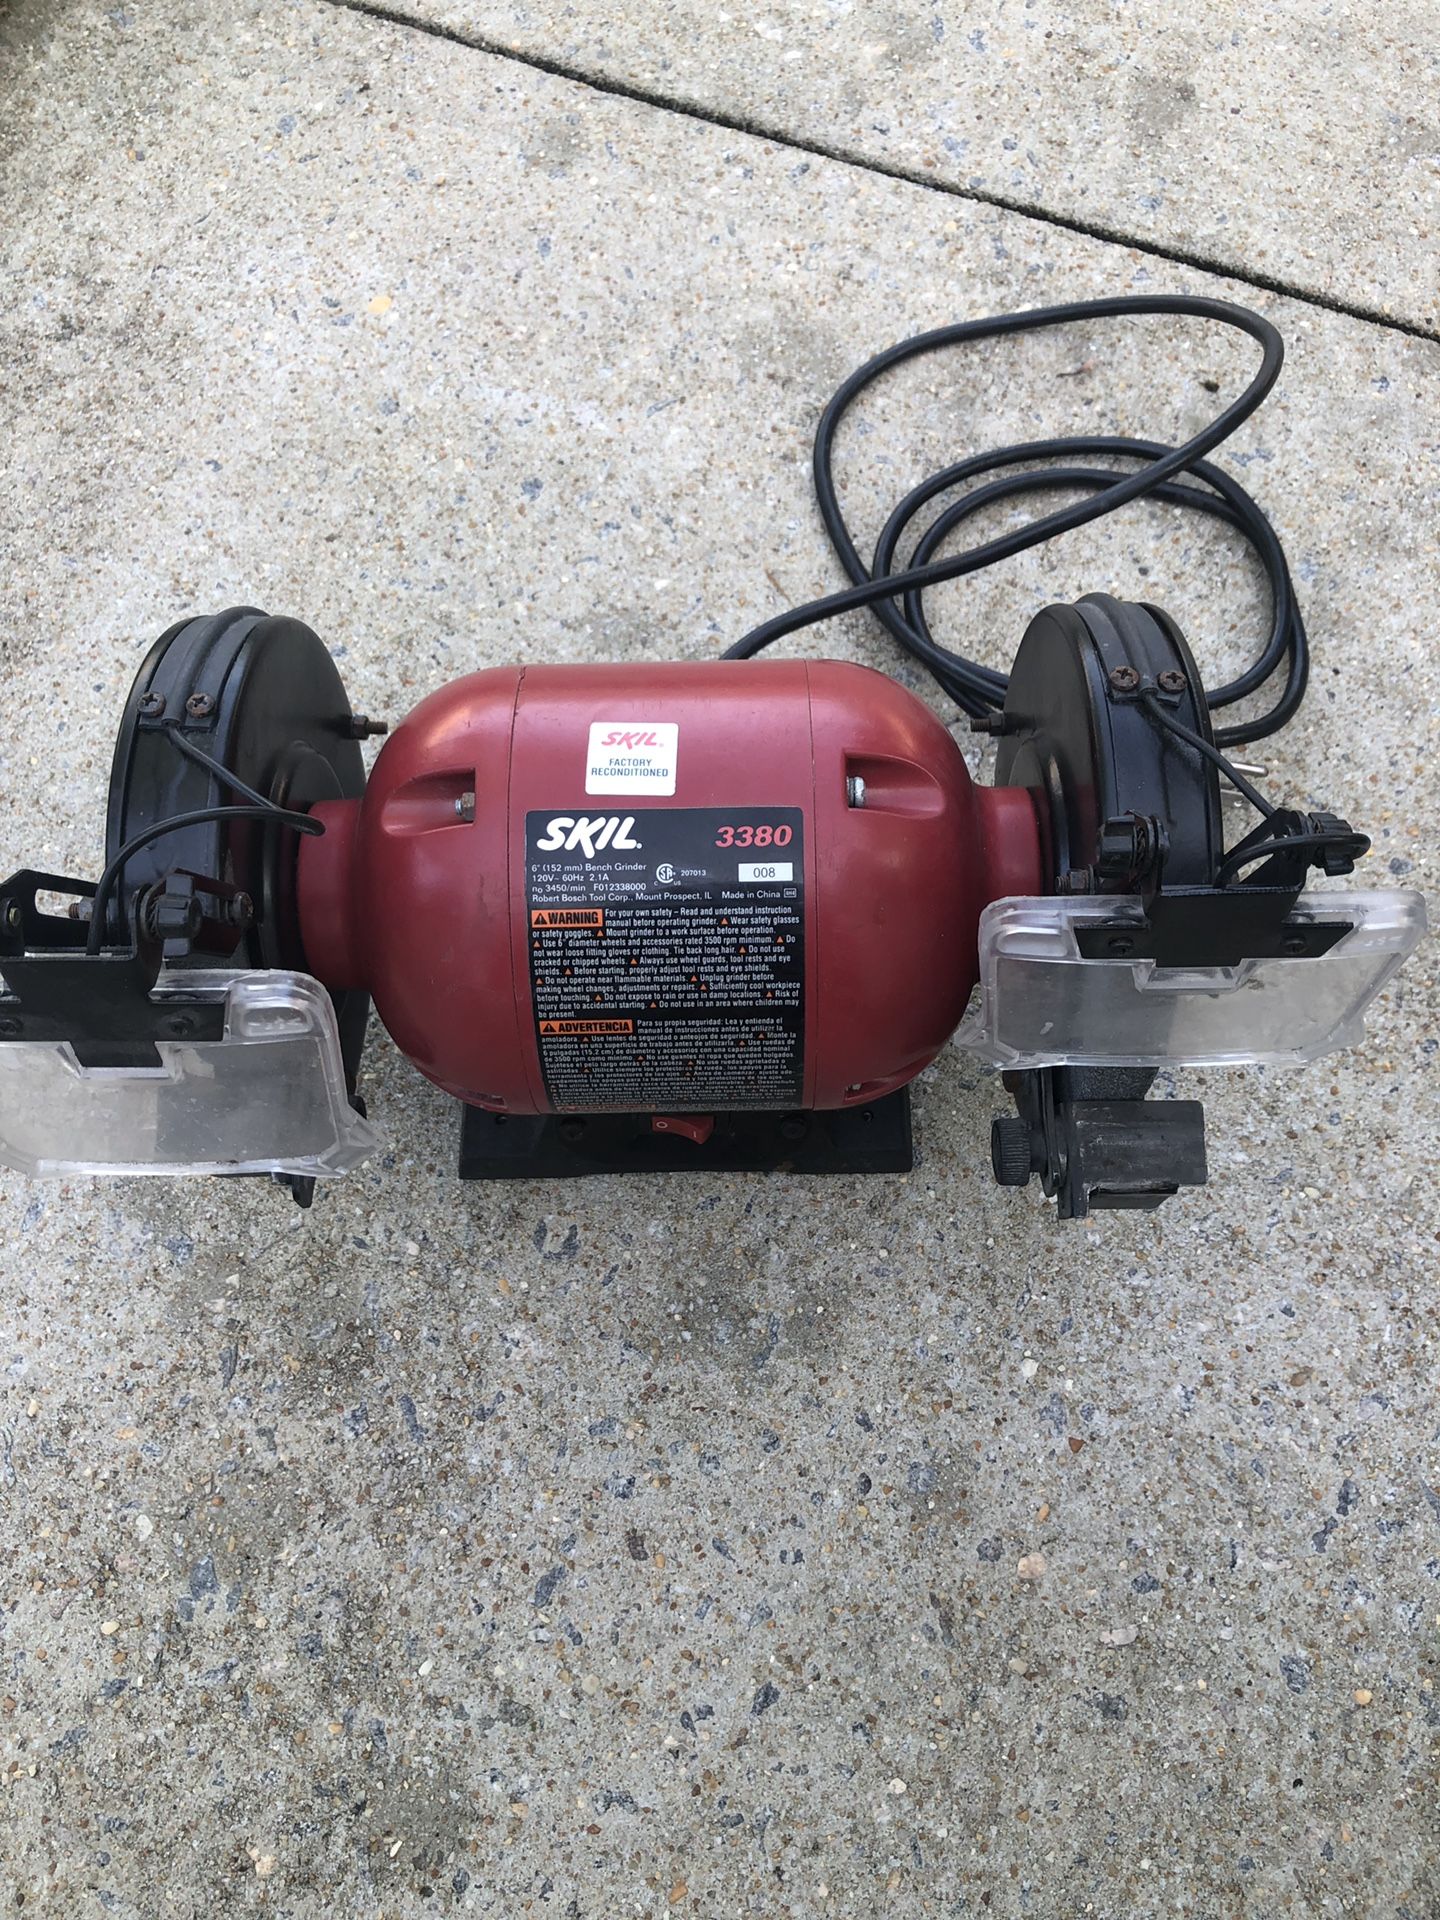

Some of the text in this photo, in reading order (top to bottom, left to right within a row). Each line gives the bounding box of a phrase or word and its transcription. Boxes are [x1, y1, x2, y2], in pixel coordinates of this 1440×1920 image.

[608, 758, 652, 767] FACTORY
[591, 768, 668, 777] RECONDITIONED
[715, 825, 792, 848] 3380
[542, 864, 562, 872] (152
[564, 864, 583, 872] mm)
[586, 863, 612, 871] Bench
[614, 862, 647, 871] Grinder
[590, 873, 609, 881] 2.1A
[753, 867, 775, 878] 008
[545, 882, 646, 892] 3450/min F012338000
[532, 894, 559, 902] Robert
[562, 894, 587, 902] Bosch
[705, 892, 712, 900] IL
[722, 891, 744, 899] Made
[747, 890, 754, 899] in
[756, 890, 780, 898] China
[619, 909, 633, 918] your
[652, 908, 672, 916] safety
[715, 906, 753, 915] understand
[755, 906, 792, 914] instruction
[548, 912, 598, 924] WARNING
[692, 918, 718, 926] grinder.
[751, 916, 771, 925] safety
[773, 916, 800, 925] glasses
[542, 929, 562, 938] safety
[564, 929, 594, 938] goggles.
[630, 928, 655, 936] grinder
[741, 926, 776, 935] operation.
[586, 948, 606, 956] fitting
[608, 948, 630, 956] gloves
[642, 947, 672, 956] clothing.
[687, 946, 702, 954] back
[704, 946, 719, 955] long
[572, 958, 599, 967] chipped
[640, 957, 664, 965] Always
[702, 956, 728, 964] guards,
[598, 966, 627, 976] starting,
[629, 966, 657, 975] properly
[660, 966, 680, 974] adjust
[619, 984, 660, 992] adjustments
[710, 982, 747, 991] Sufficiently
[710, 991, 728, 1000] damp
[619, 1001, 647, 1010] starting.
[558, 1022, 630, 1032] ADVERTENCIA
